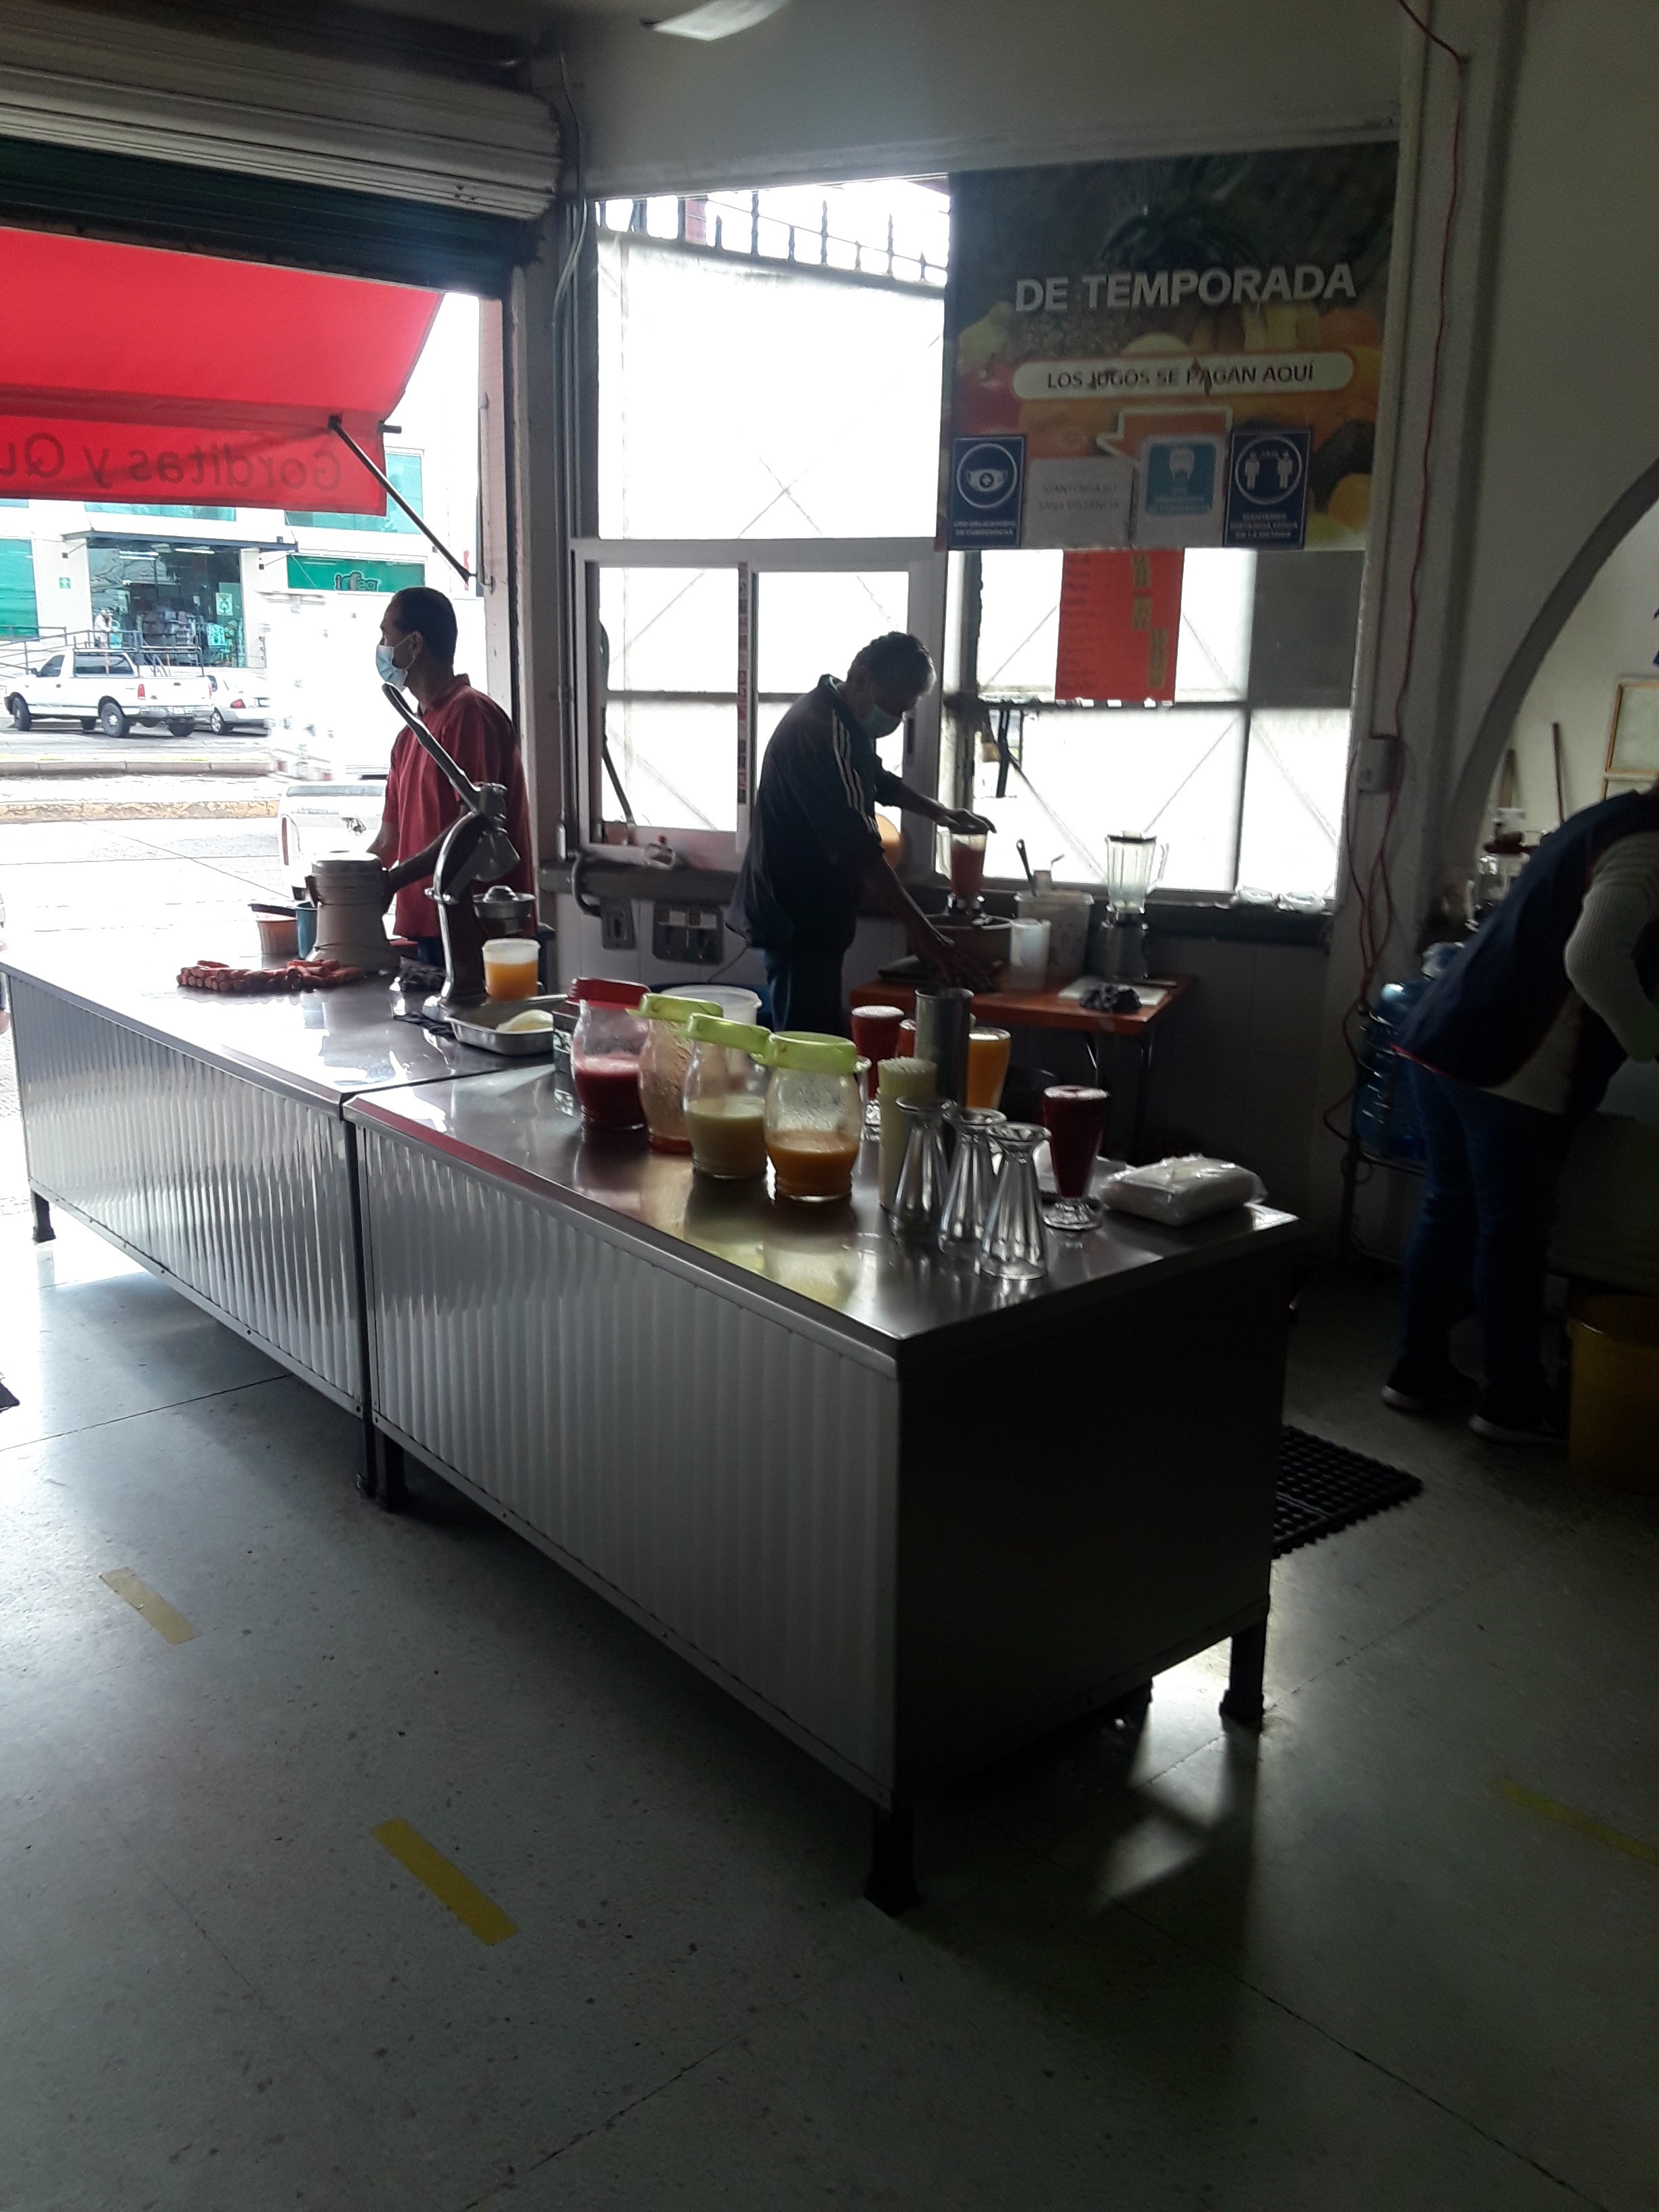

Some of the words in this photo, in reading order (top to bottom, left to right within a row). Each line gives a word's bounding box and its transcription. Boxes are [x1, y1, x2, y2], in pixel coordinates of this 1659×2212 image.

[1015, 276, 1069, 312] DE
[1082, 262, 1356, 311] TEMPORADA
[1047, 370, 1083, 390] LOS
[1156, 367, 1181, 388] SE
[1262, 359, 1315, 383] AQUÍ
